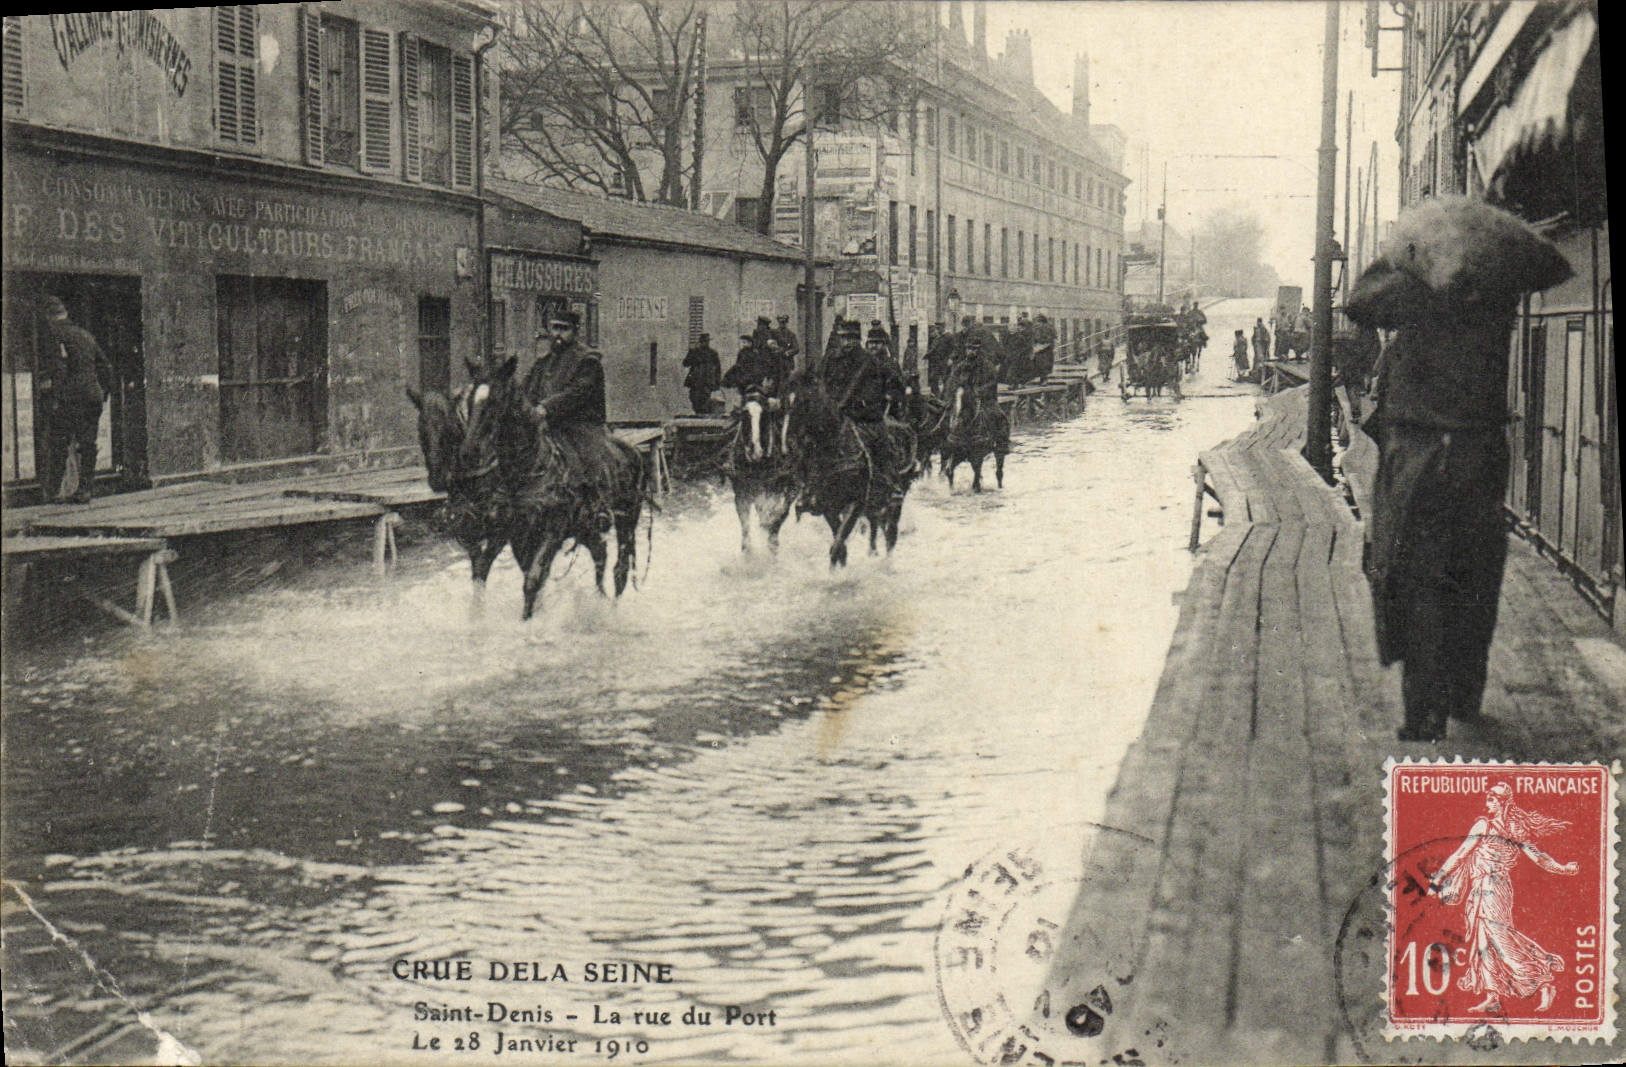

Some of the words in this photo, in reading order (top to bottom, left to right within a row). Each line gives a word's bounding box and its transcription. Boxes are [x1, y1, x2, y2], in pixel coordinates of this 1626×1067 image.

[211, 196, 245, 218] AVEC
[256, 200, 356, 228] PARTICIPATION
[57, 206, 126, 243] DES
[147, 216, 333, 259] VITICULTEURS
[491, 258, 593, 293] CHAUSSURES
[1516, 776, 1598, 795] FRANÇAISE
[1575, 925, 1596, 1009] POSTES
